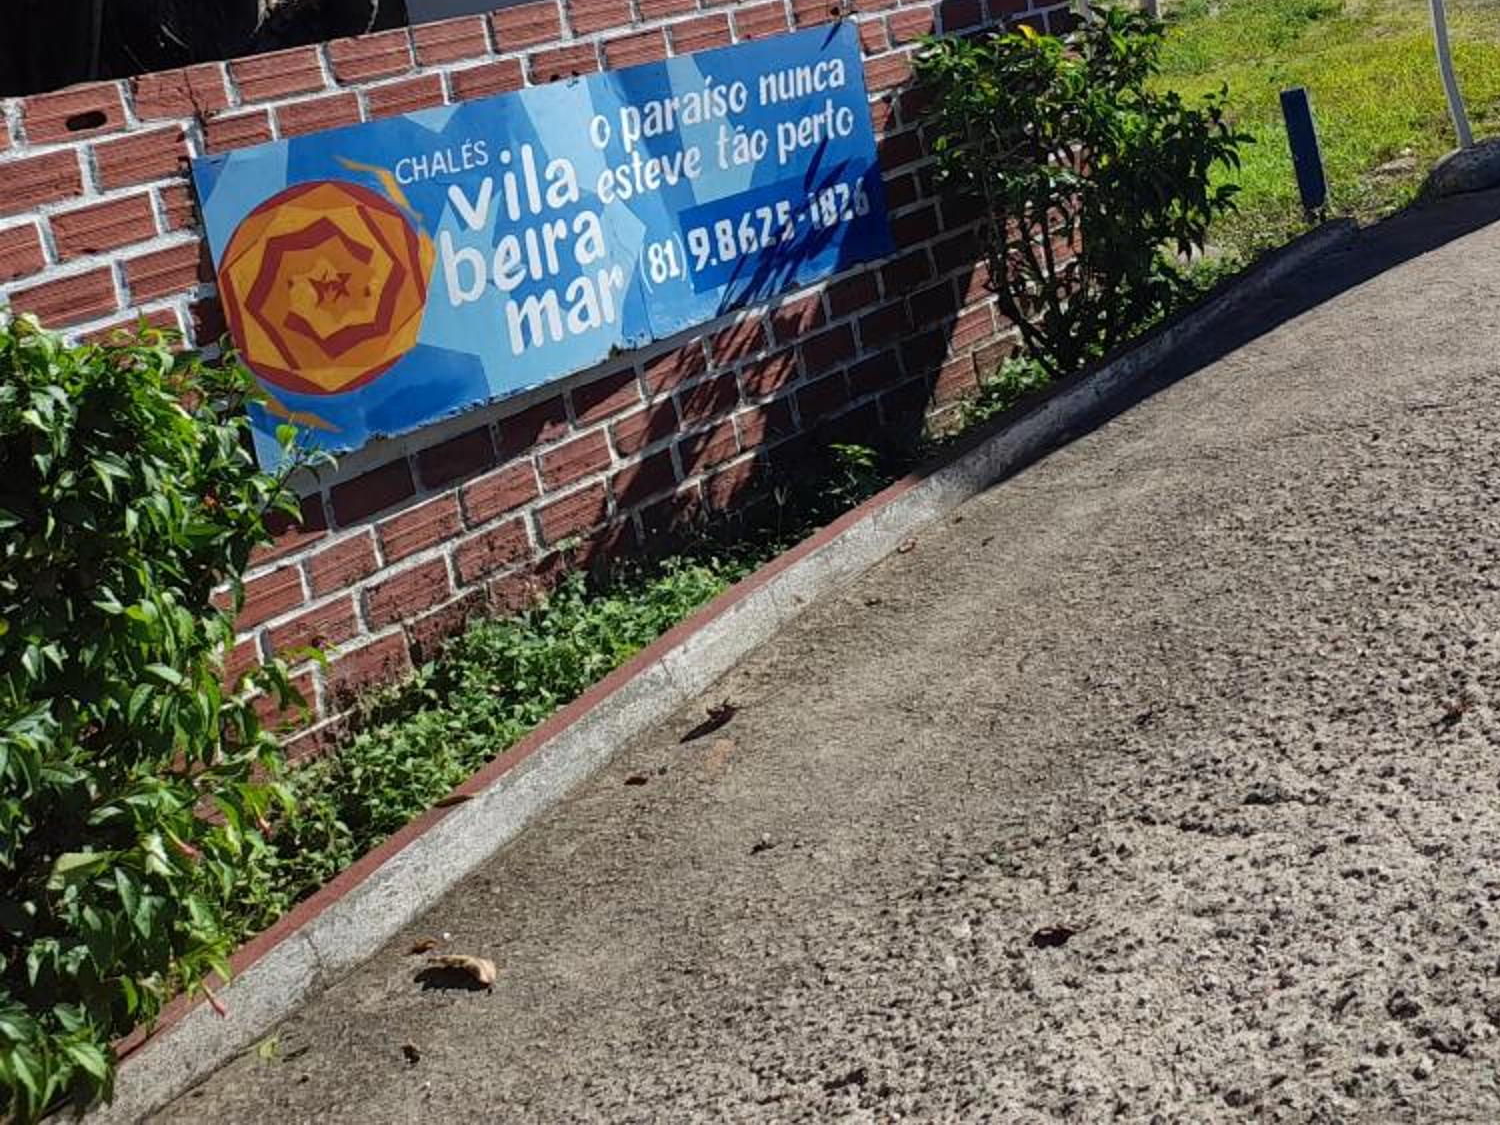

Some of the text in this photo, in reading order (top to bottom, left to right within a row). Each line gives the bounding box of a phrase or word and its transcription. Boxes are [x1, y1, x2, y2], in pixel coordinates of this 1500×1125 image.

[590, 57, 846, 153] o paraíso nunca
[394, 139, 490, 185] CHALÉS
[447, 143, 580, 232] vila
[597, 98, 854, 205] esteve tão perto
[438, 210, 606, 307] beira
[639, 230, 689, 295] (81)
[505, 265, 625, 356] mar
